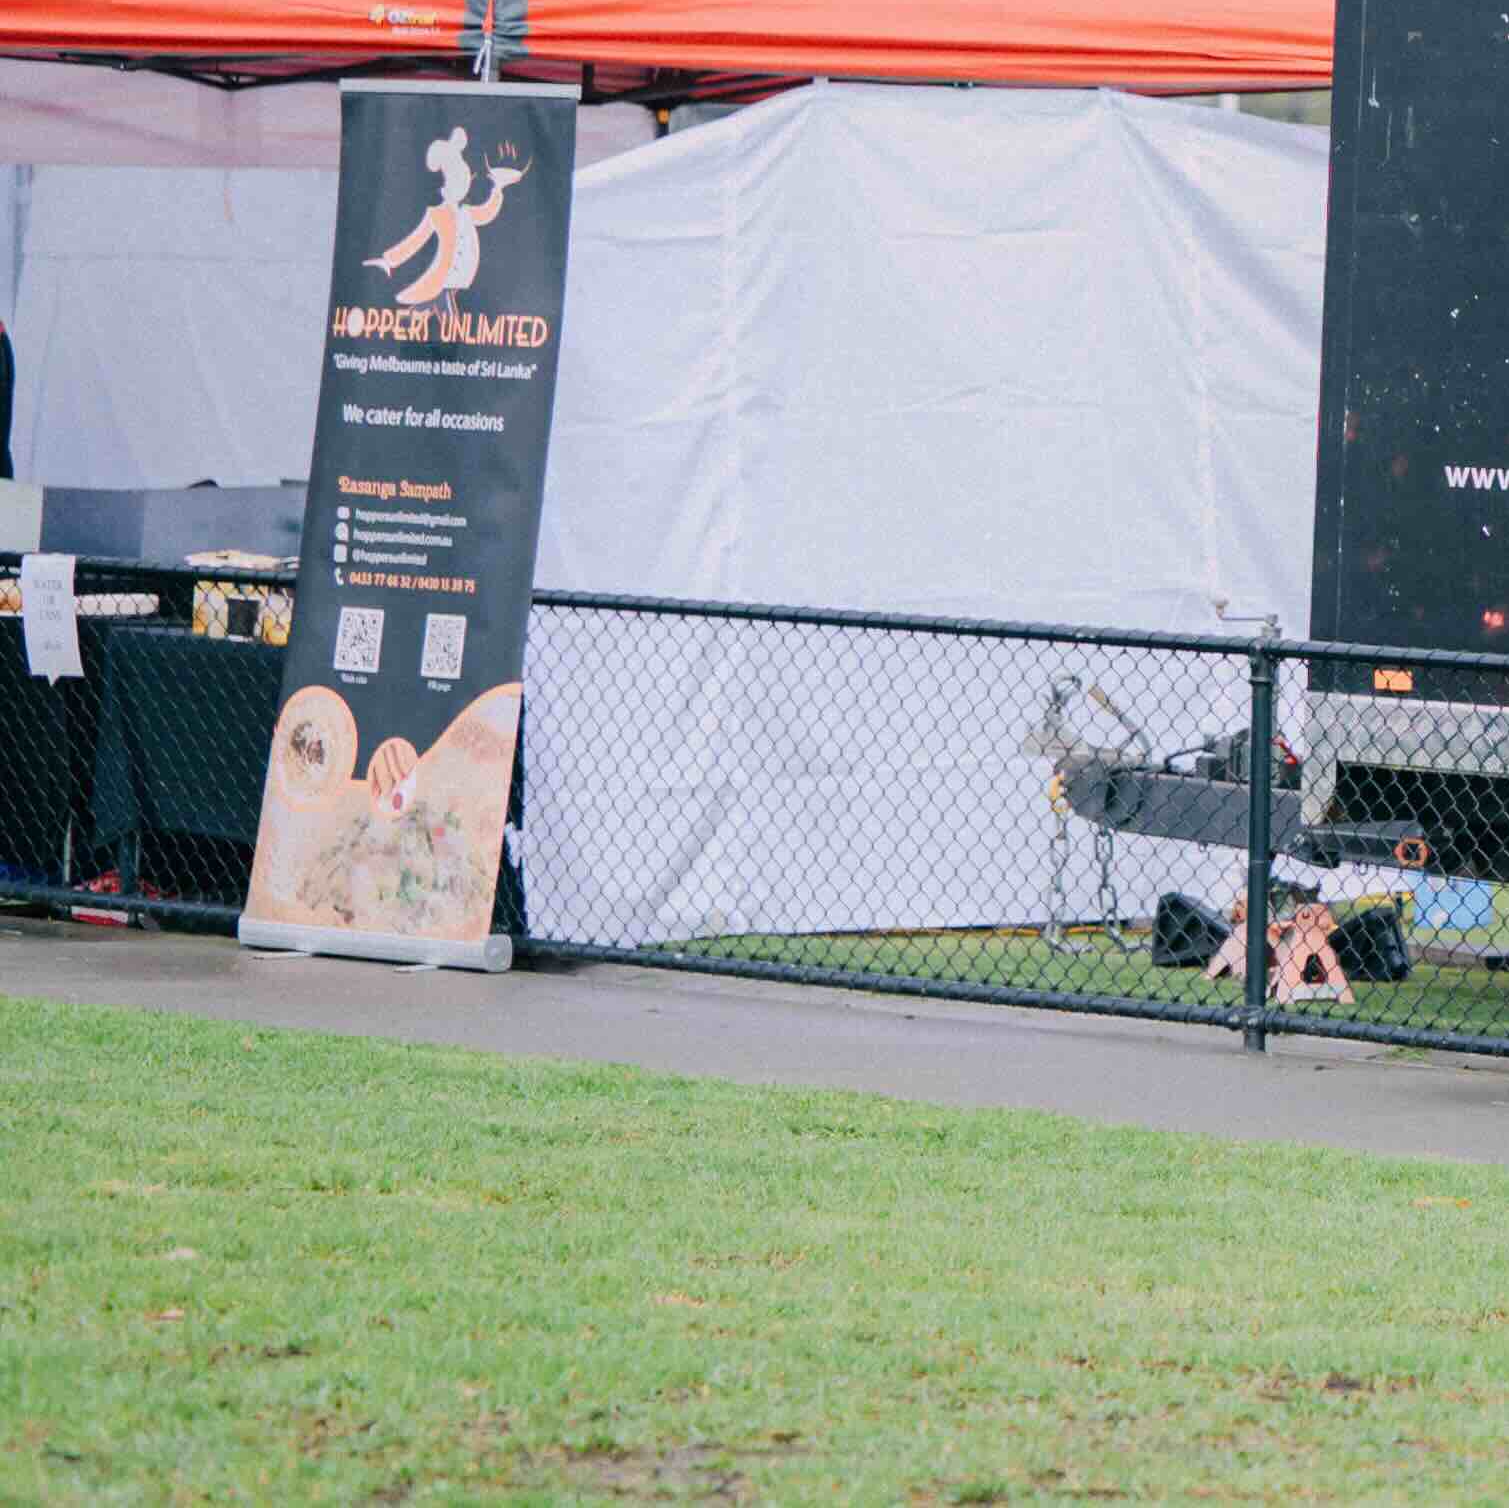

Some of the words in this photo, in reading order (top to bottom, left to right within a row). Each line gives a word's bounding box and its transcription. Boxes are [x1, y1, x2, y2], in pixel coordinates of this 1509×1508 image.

[439, 311, 550, 349] UNLIMITED
[369, 355, 433, 374] Melbourne
[467, 359, 480, 377] of
[480, 360, 496, 378] Sri
[343, 402, 364, 423] We
[365, 404, 403, 426] cater
[405, 404, 424, 428] for
[424, 407, 441, 429] all
[441, 411, 505, 432] occasions
